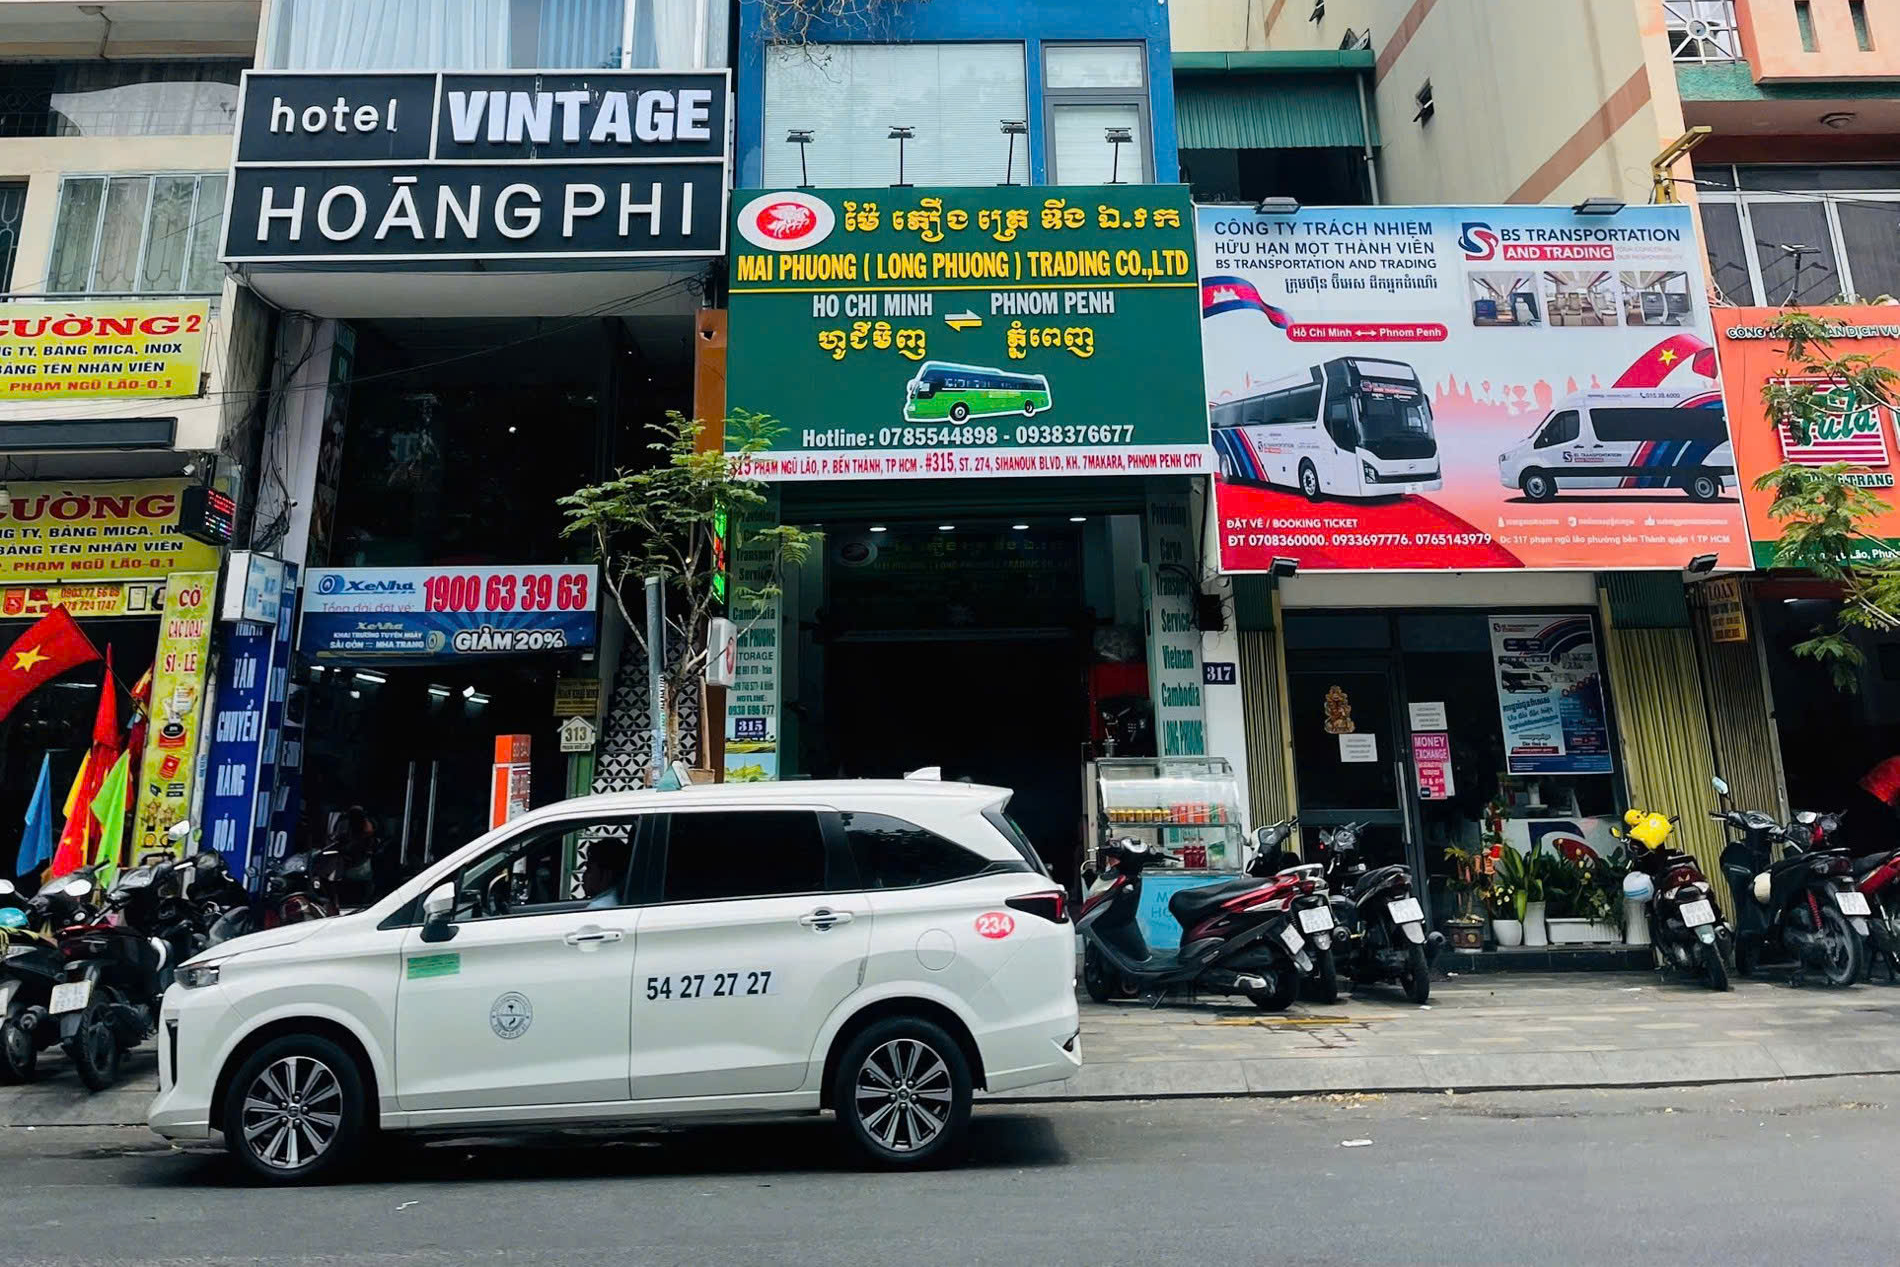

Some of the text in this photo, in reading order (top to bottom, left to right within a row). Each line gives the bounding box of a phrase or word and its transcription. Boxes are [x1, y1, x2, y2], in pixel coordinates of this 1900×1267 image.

[270, 89, 712, 144] hotel VINTAGE
[1214, 218, 1268, 236] CÔNG
[1273, 222, 1301, 235] TY
[1303, 219, 1368, 235] TRÁCH
[1501, 229, 1680, 241] BS TRANSPORTATION
[1215, 238, 1250, 254] HỮU
[1256, 241, 1289, 257] HẠN
[1335, 239, 1391, 254] THÀNH
[1396, 238, 1434, 254] VIÊN
[1506, 247, 1540, 258] AND
[1543, 247, 1612, 259] TRADING
[737, 255, 773, 281] MAI
[779, 253, 857, 281] PHUONG
[877, 252, 926, 279] LONG
[932, 251, 1009, 279] PHUONG
[1027, 250, 1111, 278] TRADING
[1115, 249, 1189, 281] CO.,LTD
[1216, 259, 1437, 269] BS TRANSPORTATION AND TRADING
[812, 293, 933, 318] HO CHI MINH
[990, 291, 1115, 315] PHNOM PENH
[0, 313, 201, 337] ƯỜNG 2
[1309, 328, 1327, 337] Chi
[1329, 328, 1352, 337] Minh
[1380, 328, 1414, 337] Phnom
[1417, 328, 1441, 337] Penh
[145, 343, 182, 353] INOX
[43, 362, 71, 373] TÊN
[129, 360, 164, 372] VIÊN
[10, 379, 101, 392] PHẠM NGŨ
[802, 429, 875, 448] Hotline:
[879, 426, 997, 446] 0785544898
[1016, 424, 1134, 444] 0938376677
[781, 457, 797, 475] NGŨ
[800, 457, 820, 475] LÃO,
[822, 460, 830, 474] P.
[832, 454, 850, 474] BẾN
[853, 455, 883, 475] THÀNH,
[885, 459, 896, 473] TP
[899, 458, 917, 473] HCM
[925, 452, 957, 474] #315,
[960, 457, 972, 471] ST.
[975, 456, 993, 474] 274,
[995, 455, 1036, 471] SIHANOUK
[1127, 454, 1157, 469] PHNOM
[1159, 453, 1182, 469] PENH
[1184, 453, 1203, 469] CITY
[0, 491, 176, 521] ƯỜNG
[1272, 518, 1321, 529] BOOKING
[1323, 518, 1358, 529] TICKET
[50, 542, 81, 553] TÊN
[144, 540, 183, 551] VIÊN
[1228, 535, 1245, 547] ĐT
[1416, 534, 1491, 545] 0765143979
[13, 558, 104, 573] PHẠM NGŨ
[179, 584, 201, 608] CỜ
[423, 574, 481, 612] 1900
[485, 574, 517, 612] 63
[522, 574, 553, 611] 39
[556, 573, 589, 611] 63
[1161, 608, 1191, 634] Service
[454, 626, 564, 651] GIẢM 20%
[1162, 645, 1193, 670] Vietnam
[233, 652, 257, 695] VẬN
[1207, 665, 1231, 682] 317
[1161, 682, 1200, 708] Cambodia
[565, 726, 587, 743] 313
[739, 720, 763, 732] 315
[1414, 736, 1445, 747] MONEY
[1415, 748, 1448, 760] EXCHANGE
[979, 916, 1010, 933] 234
[647, 971, 772, 1000] 54 27 27 27
